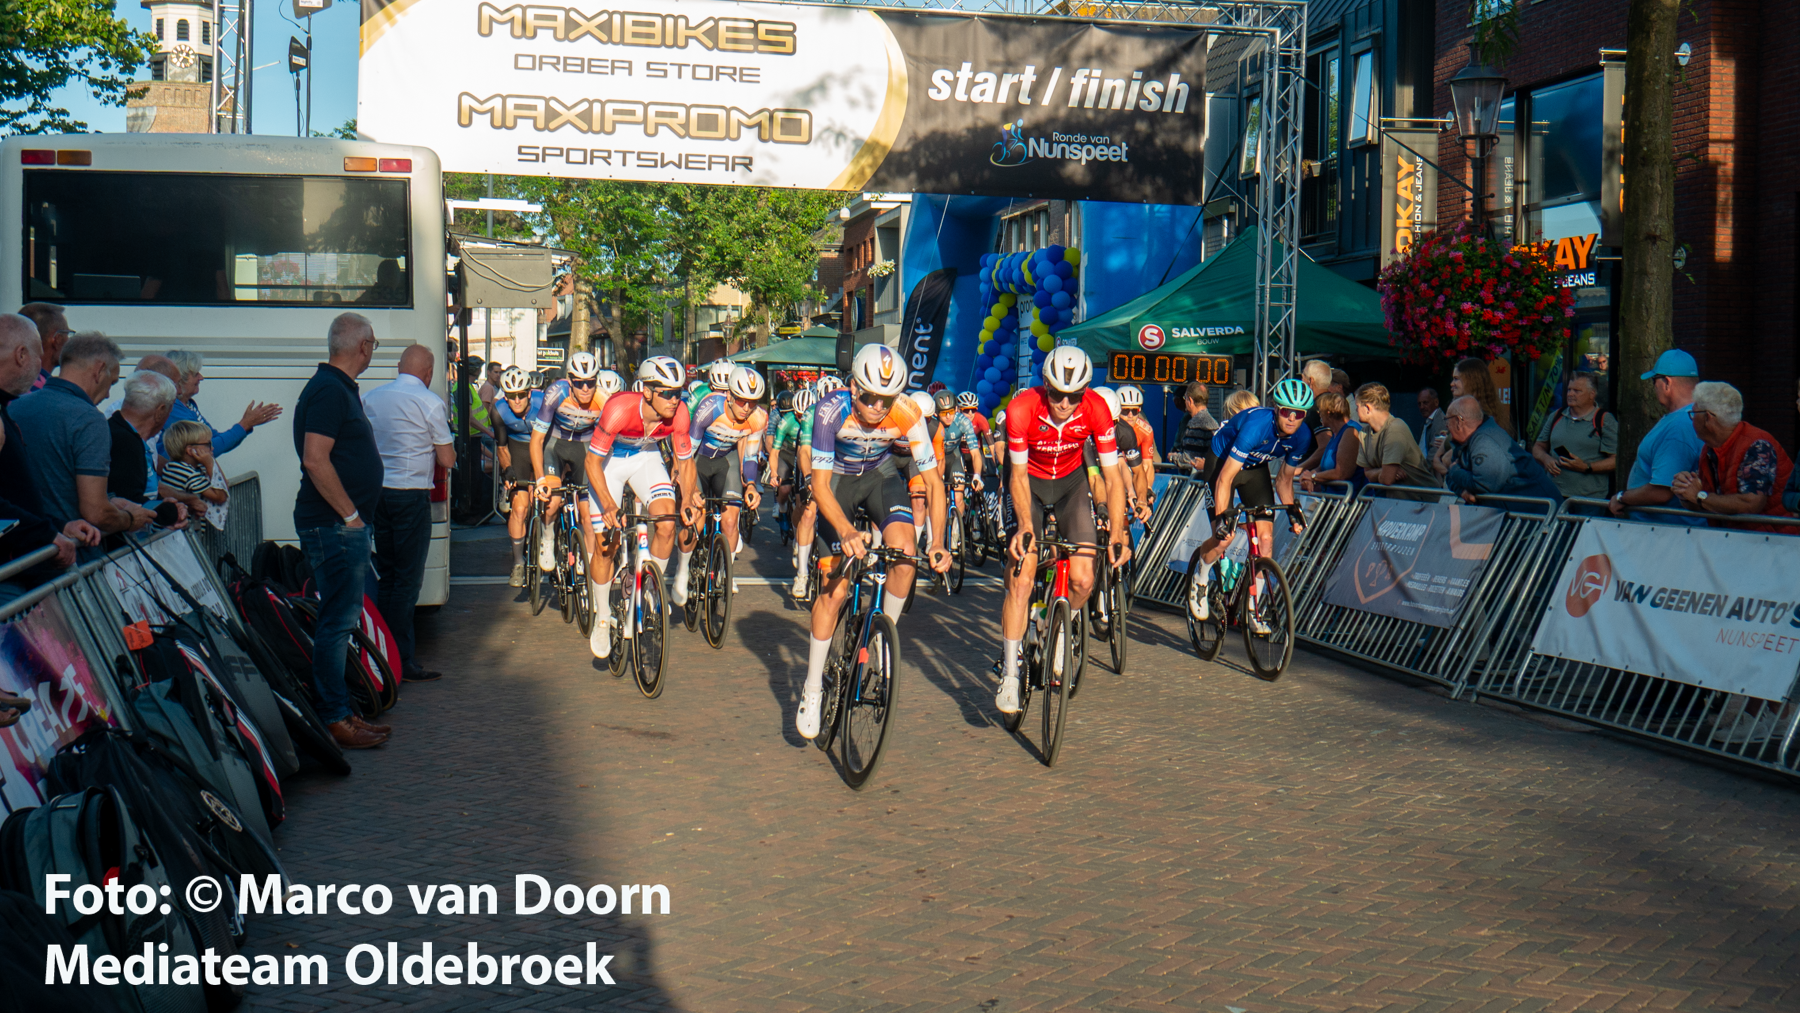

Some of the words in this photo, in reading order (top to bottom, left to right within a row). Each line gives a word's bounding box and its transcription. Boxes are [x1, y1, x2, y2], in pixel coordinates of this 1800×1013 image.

[478, 2, 797, 56] MAXIBIKES
[514, 53, 633, 77] ORBEA
[645, 61, 760, 84] STORE
[928, 62, 1037, 105] start
[1041, 67, 1062, 106] /
[1068, 68, 1190, 114] finish
[457, 92, 813, 145] MAXIPROMO
[1028, 137, 1128, 165] Nunspeet
[1052, 131, 1086, 144] Ronde
[1090, 135, 1110, 145] van
[517, 145, 753, 173] SPORTSWEAR
[1414, 156, 1423, 192] JEANS
[1396, 155, 1414, 254] OKAY
[1414, 205, 1422, 247] SHION
[1171, 325, 1245, 338] SALVERDA
[1197, 338, 1219, 346] BOUW
[1113, 354, 1146, 380] 00
[1155, 355, 1187, 382] 00
[1196, 357, 1229, 384] 00
[1614, 579, 1650, 605] VAN
[1649, 586, 1729, 617] GEENEN
[1715, 628, 1799, 655] NUNSPEET
